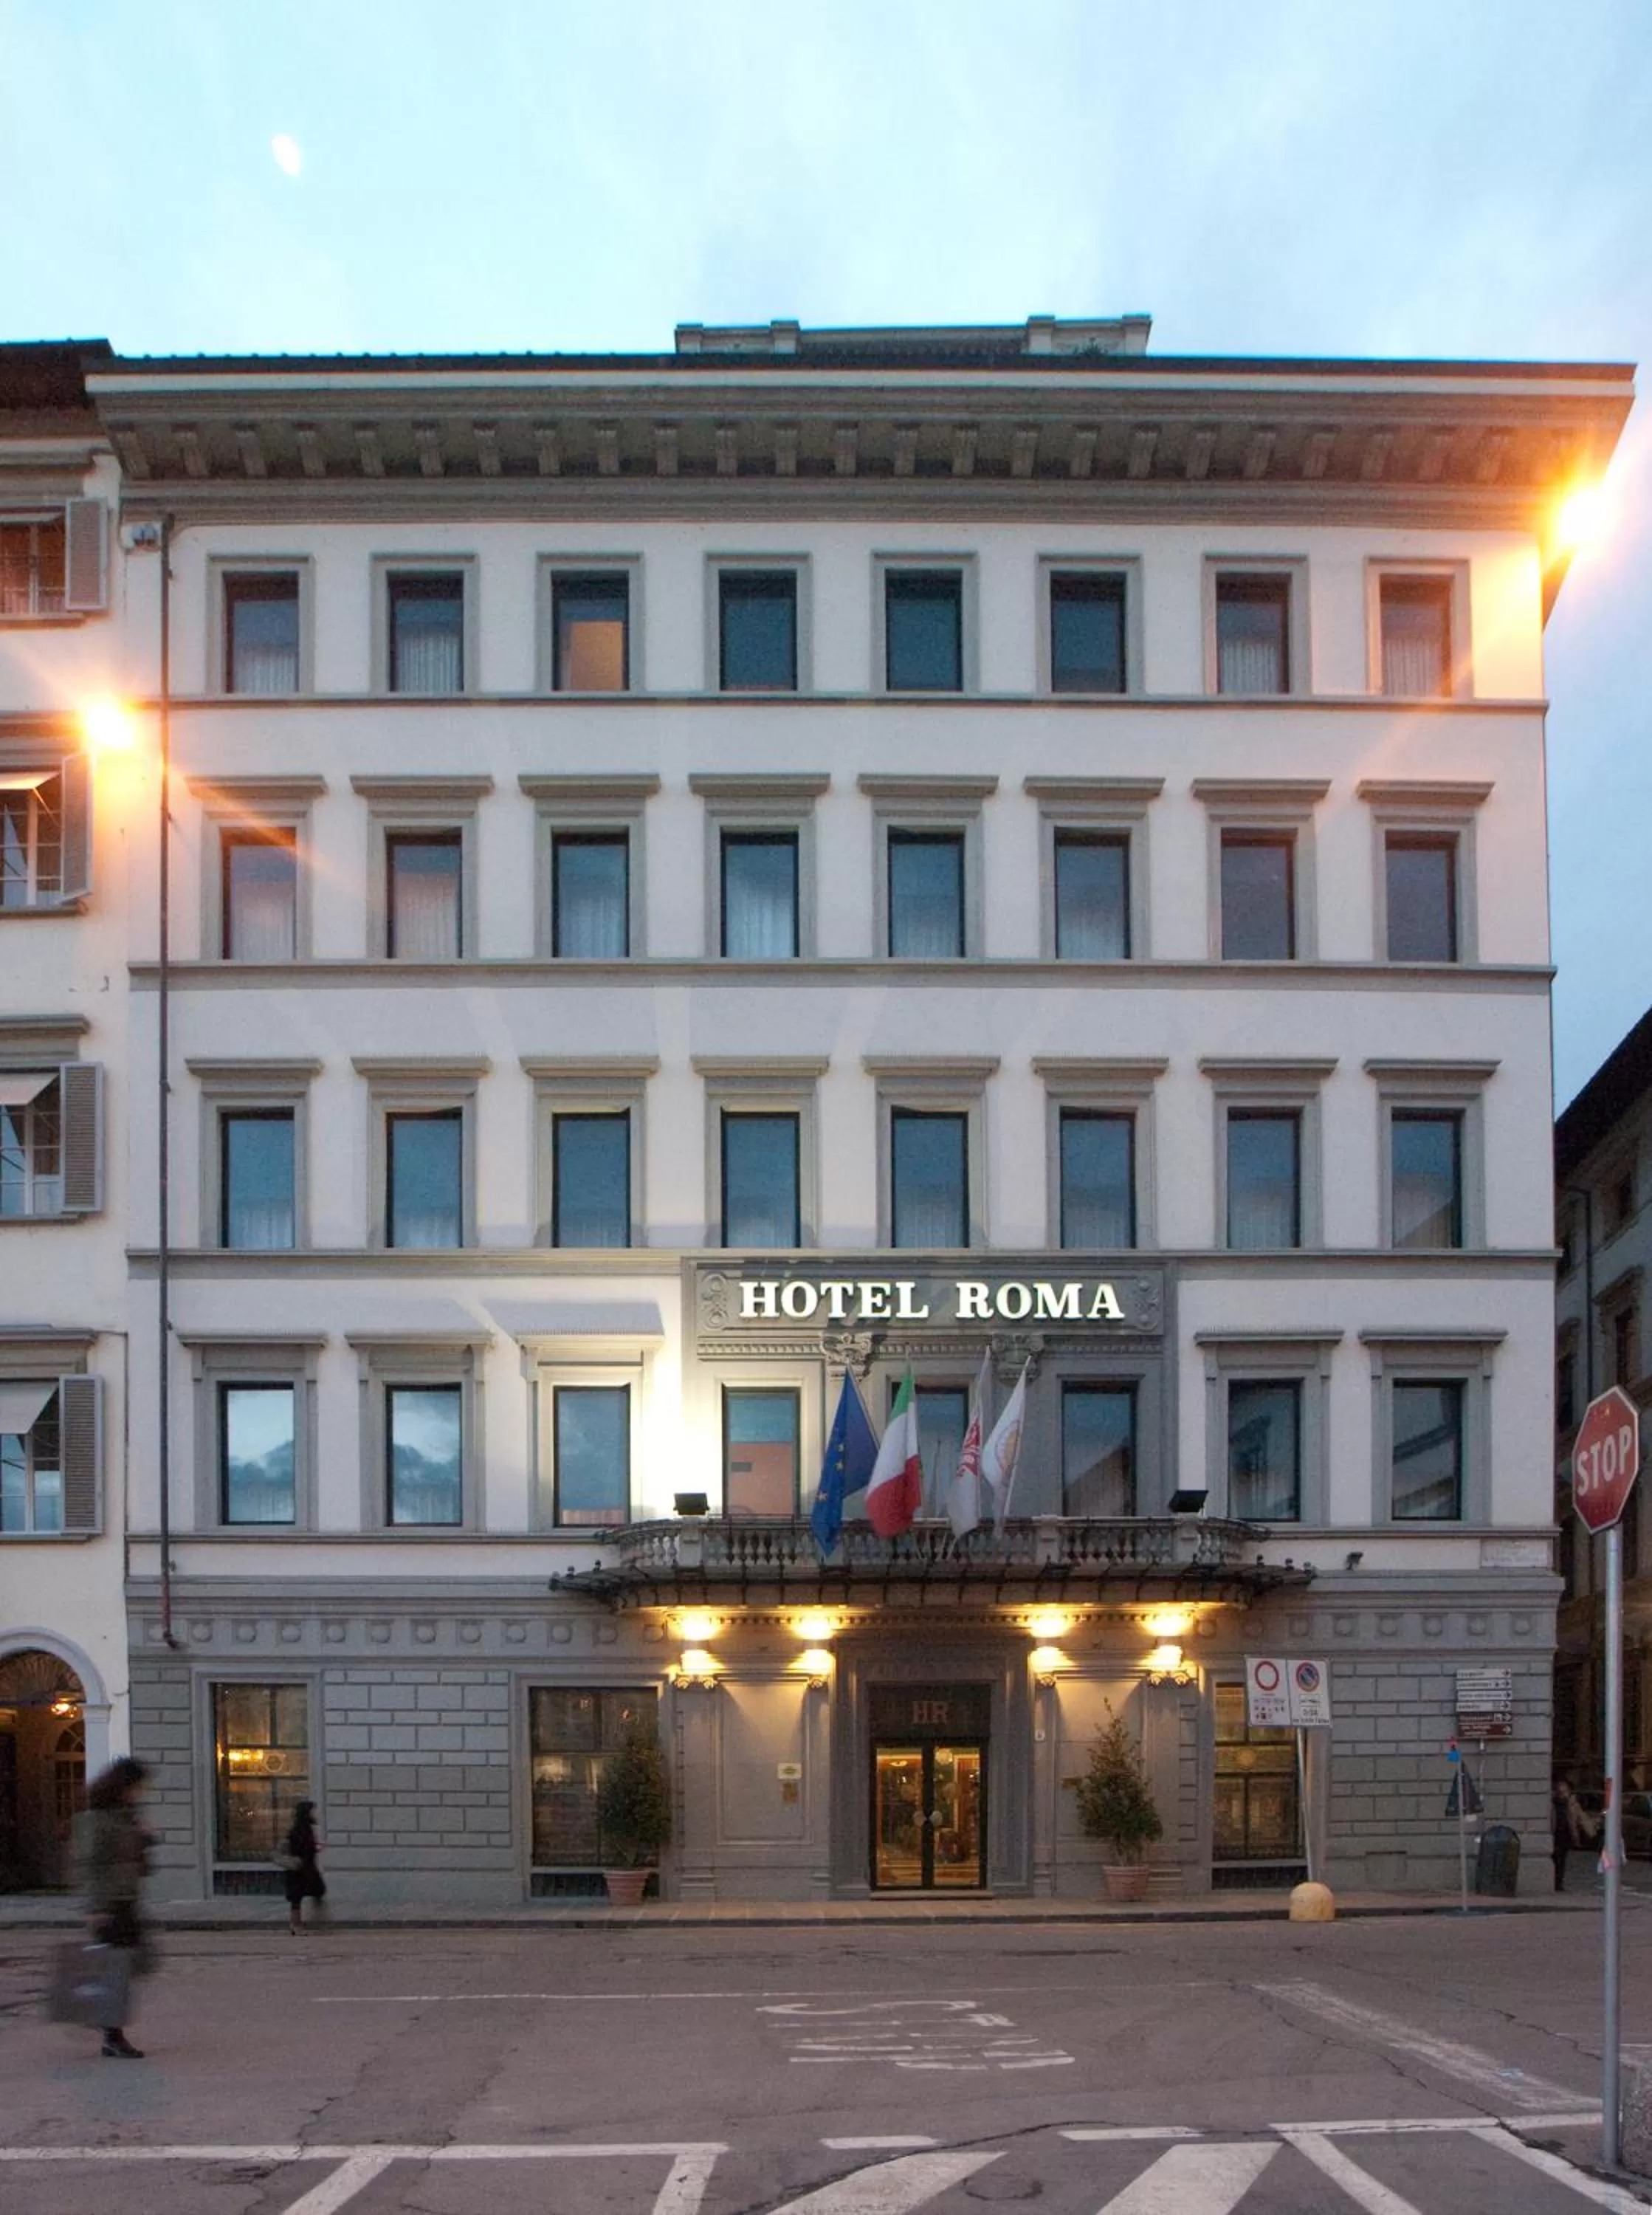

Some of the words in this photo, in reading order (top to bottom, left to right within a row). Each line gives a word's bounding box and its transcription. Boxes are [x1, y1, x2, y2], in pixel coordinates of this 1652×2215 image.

[739, 1281, 929, 1318] HOTEL
[956, 1282, 1126, 1319] ROMA
[1577, 1424, 1633, 1496] STOP
[912, 1700, 949, 1725] HR
